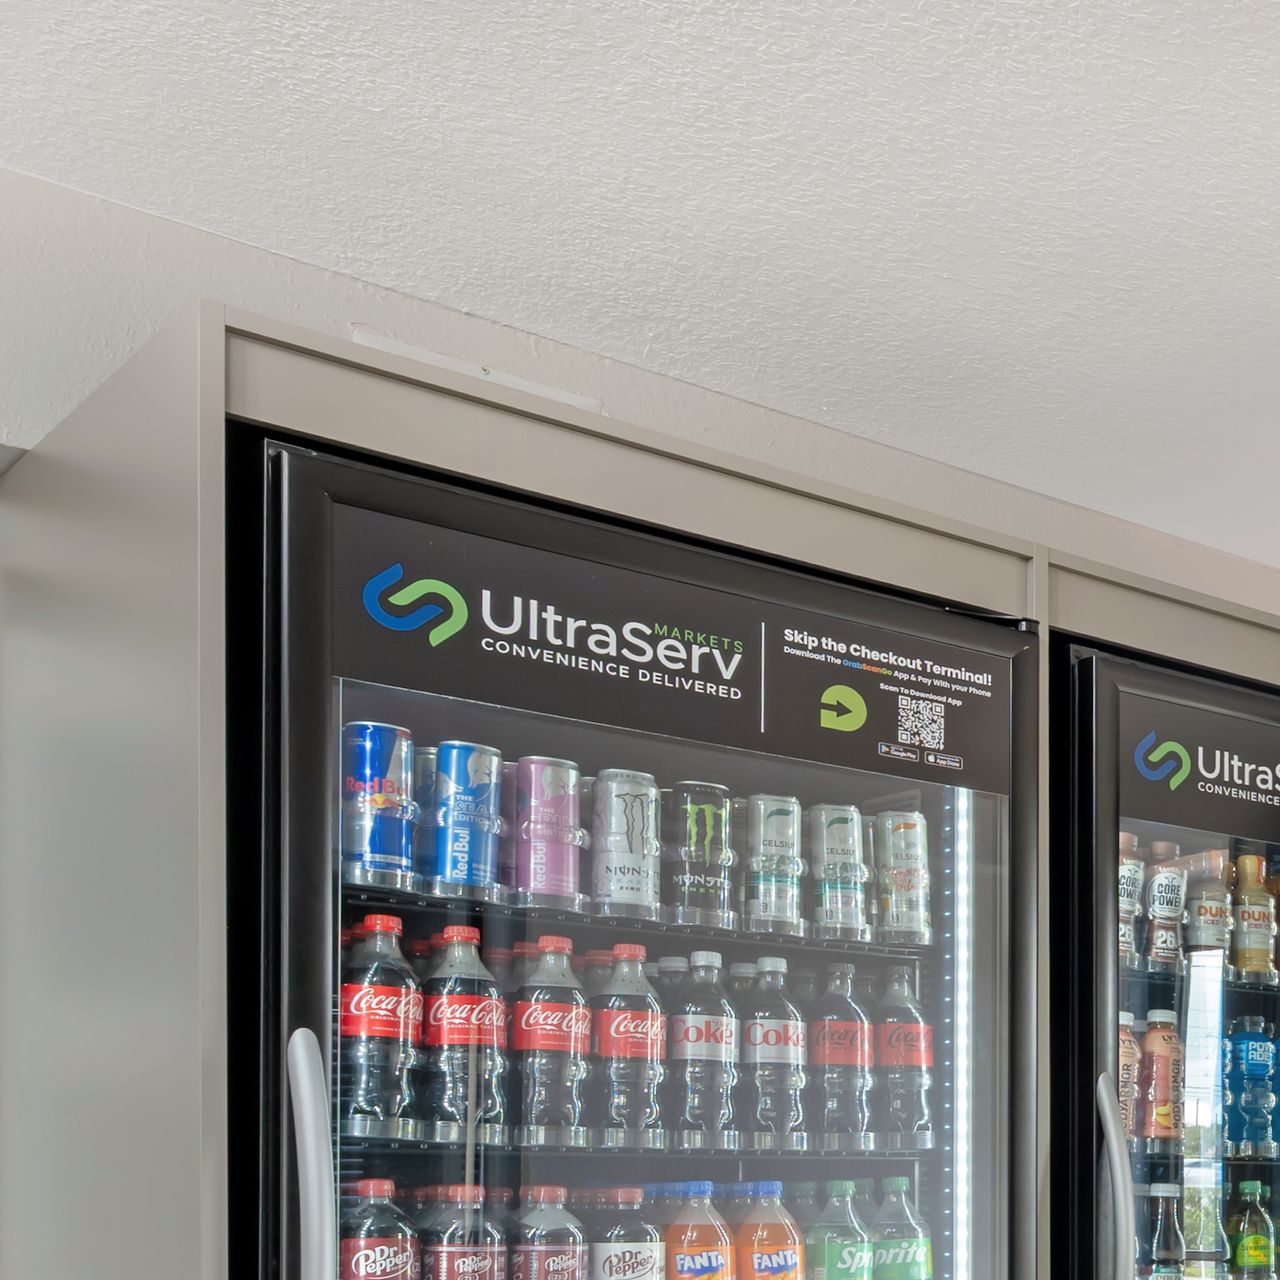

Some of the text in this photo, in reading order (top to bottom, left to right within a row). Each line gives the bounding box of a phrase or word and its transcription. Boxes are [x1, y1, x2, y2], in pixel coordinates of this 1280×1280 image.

[481, 589, 742, 680] UltraServ
[655, 623, 743, 653] MARKETS
[481, 637, 742, 699] CONVENIENCE DELIVERED
[784, 629, 992, 686] Skip the Checkout Terminal!
[784, 646, 825, 662] Download
[826, 654, 842, 665] The
[842, 659, 893, 676] GrabScanGo
[893, 671, 909, 682] App
[918, 676, 932, 686] Pay
[933, 678, 950, 689] With
[951, 683, 968, 694] your
[968, 684, 992, 697] Phone
[880, 683, 963, 707] Scan To Download App
[346, 776, 379, 793] Red
[1198, 781, 1280, 806] CONVENIENCE
[453, 827, 469, 880] Red Bull
[1157, 883, 1181, 895] CORE
[1156, 930, 1176, 947] 26
[670, 1019, 733, 1046] Coke
[358, 1250, 411, 1276] Pepper
[374, 1245, 398, 1262] Dr
[470, 1255, 483, 1266] Dr
[545, 1256, 578, 1273] Pepper
[557, 1253, 571, 1264] Dr
[608, 1251, 653, 1279] Pepper
[622, 1249, 641, 1265] Dr
[675, 1251, 724, 1271] FANTA
[455, 1258, 491, 1275] Pepper
